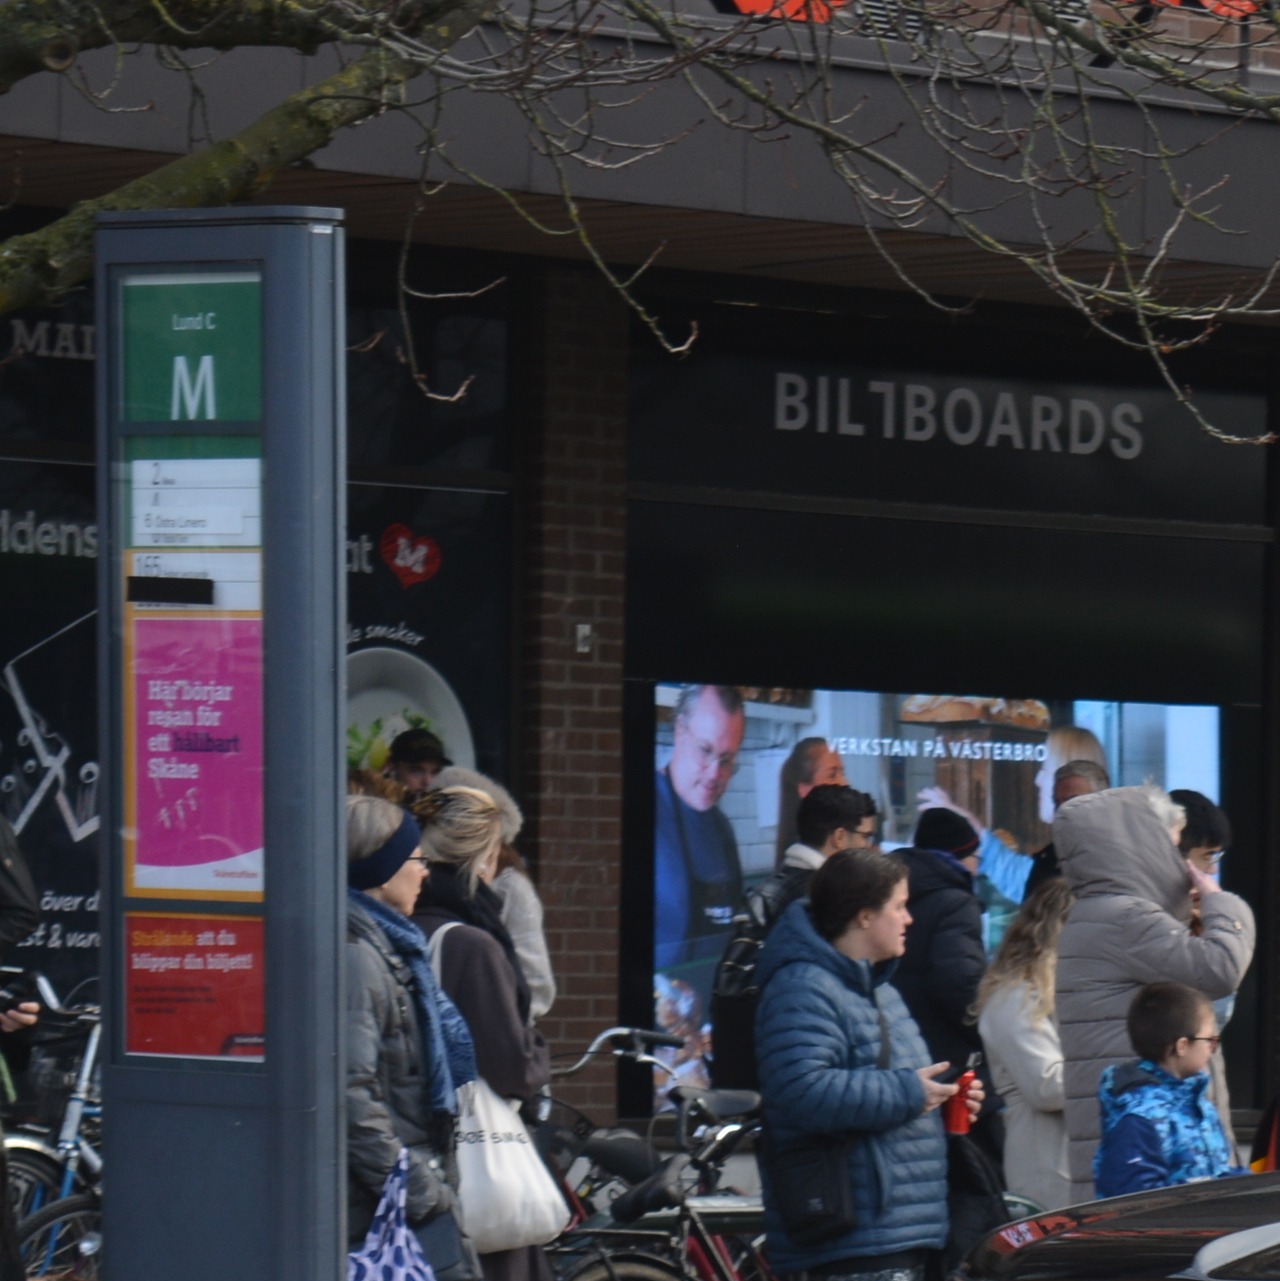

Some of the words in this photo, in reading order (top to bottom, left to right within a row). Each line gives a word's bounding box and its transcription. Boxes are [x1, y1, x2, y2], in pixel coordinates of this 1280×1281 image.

[204, 312, 217, 330] C
[170, 355, 217, 421] M
[827, 736, 918, 758] VERKSTAN
[922, 736, 945, 759] PÅ
[948, 738, 1048, 763] VÄSTERBRO
[146, 756, 200, 779] Skåne
